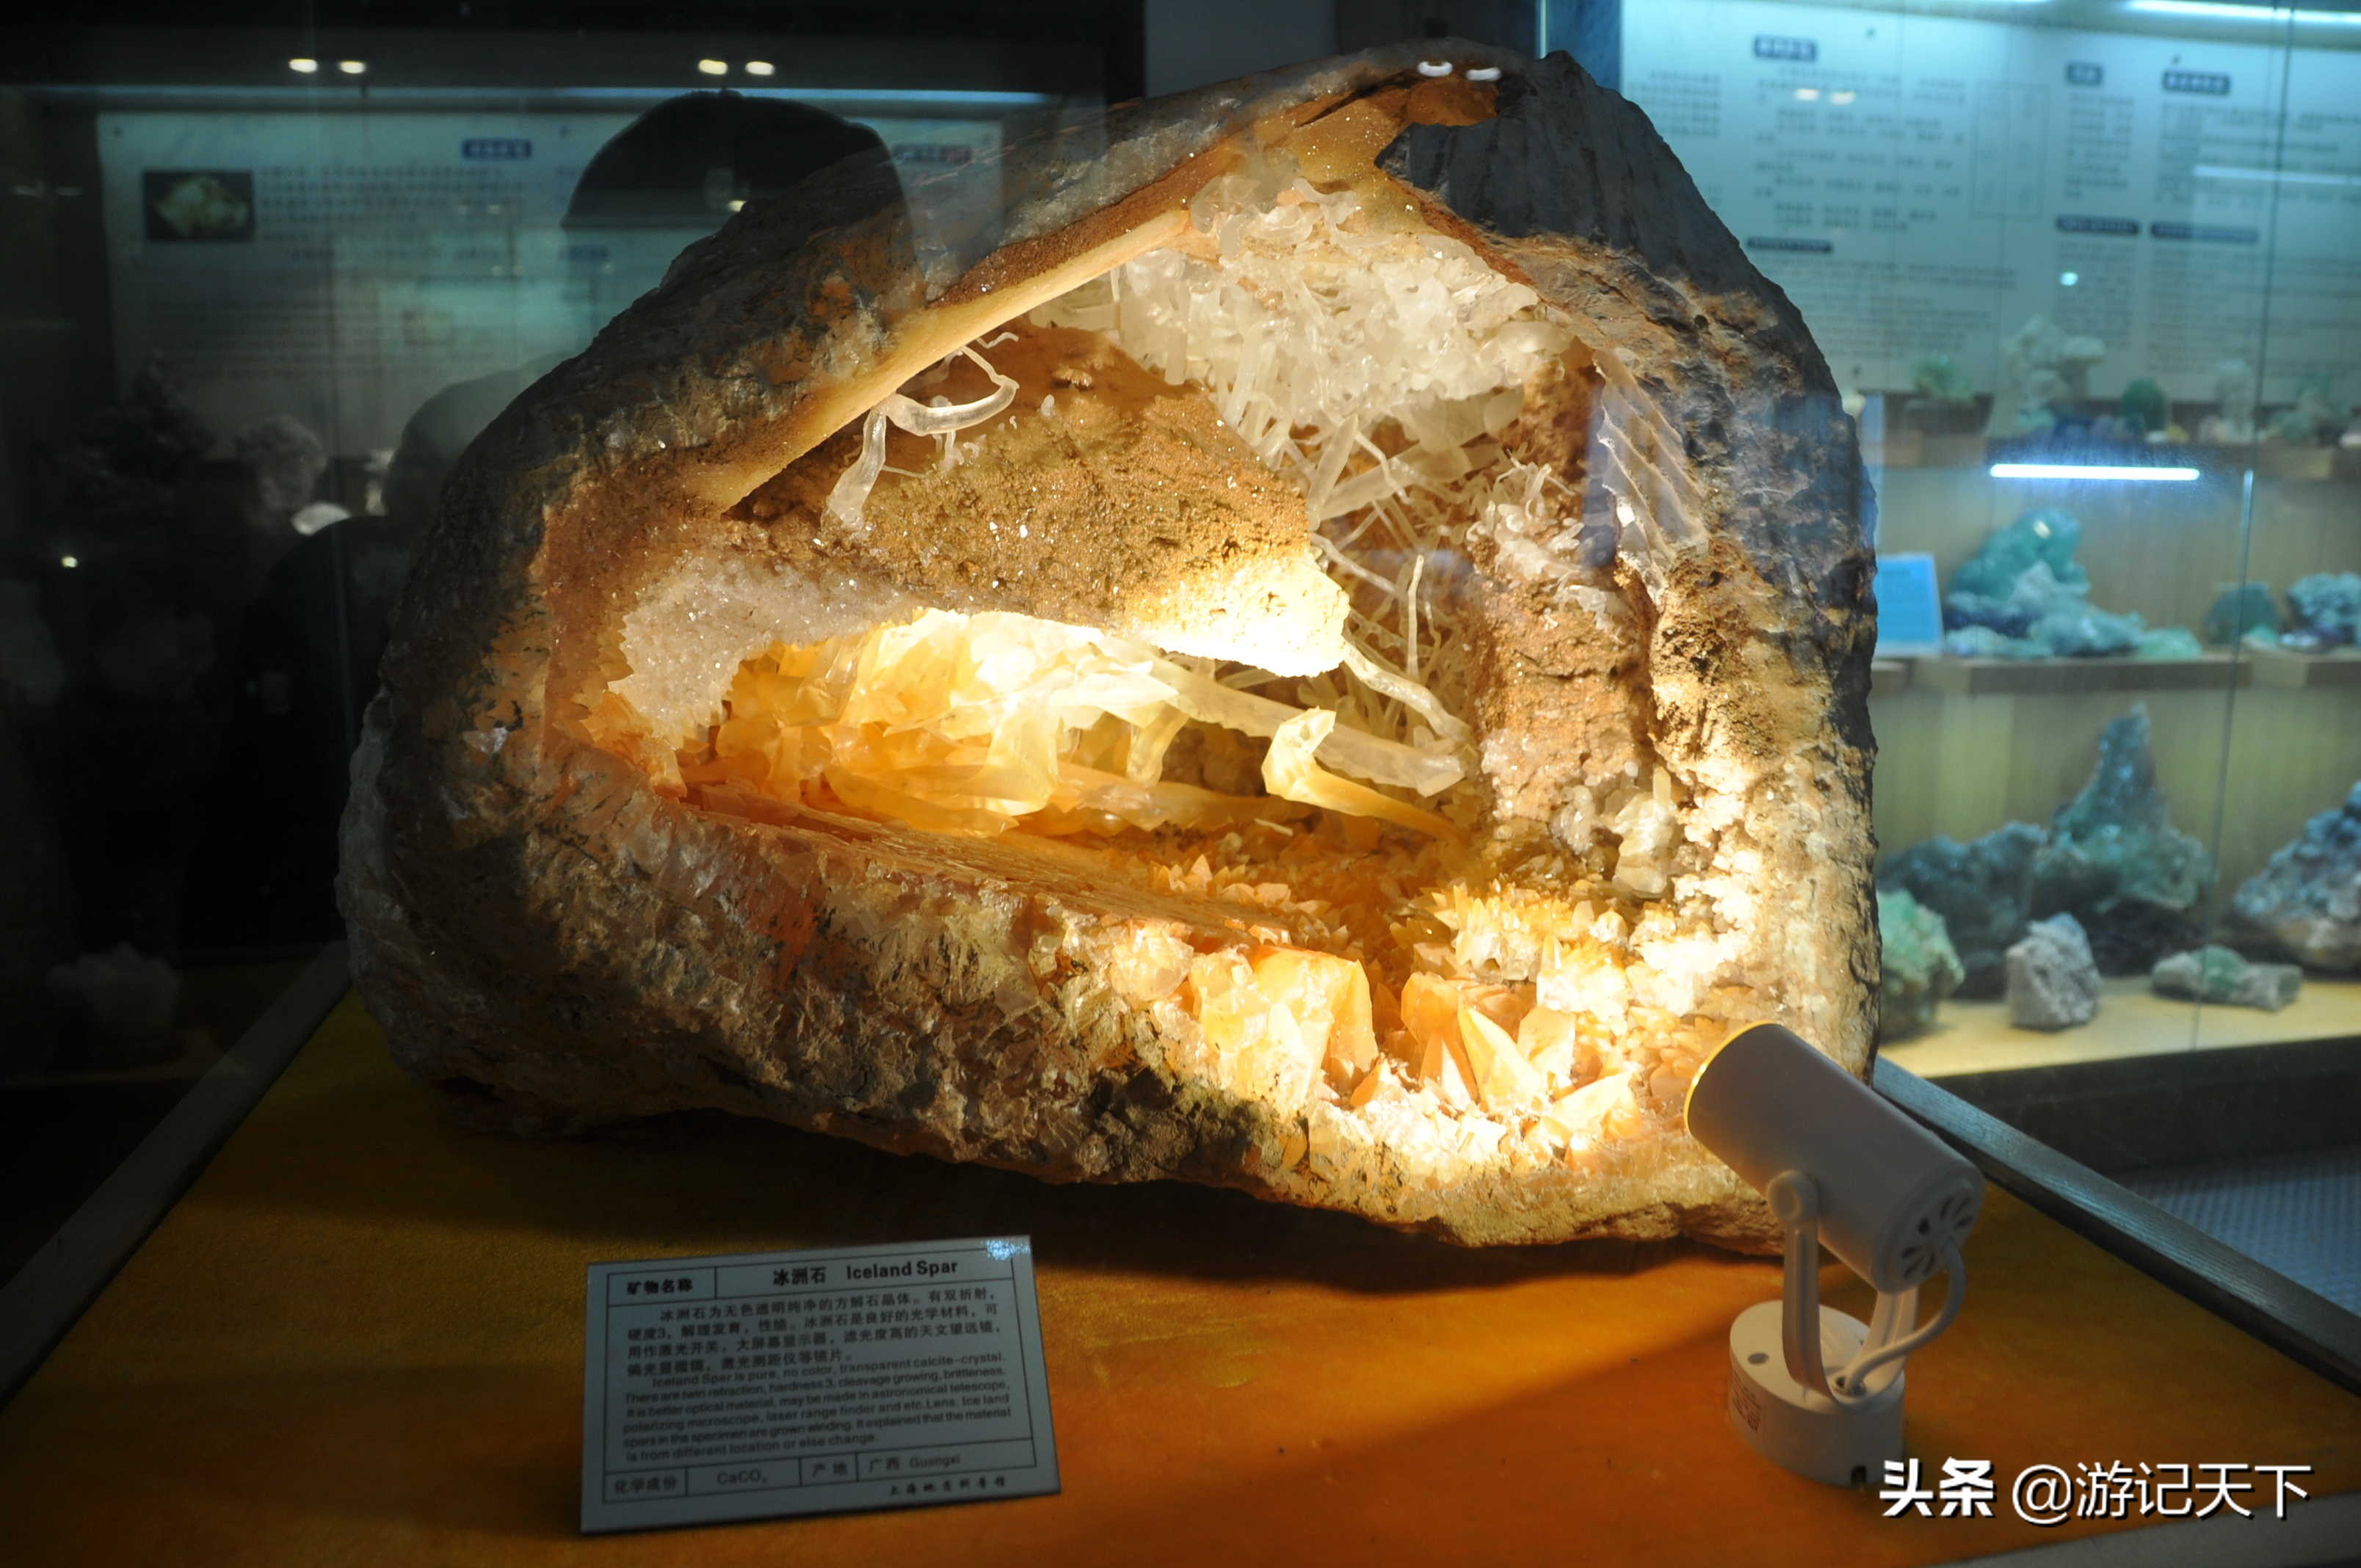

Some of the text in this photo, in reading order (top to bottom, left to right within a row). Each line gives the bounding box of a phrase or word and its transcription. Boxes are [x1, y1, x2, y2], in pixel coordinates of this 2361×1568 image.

[773, 1260, 958, 1285] 冰洲石 Iceland Spar
[627, 1278, 692, 1293] 矿物名称
[652, 1374, 698, 1387] Iceland
[702, 1372, 731, 1386] Spar
[839, 1359, 910, 1376] transparent
[838, 1373, 891, 1389] cleavage
[685, 1401, 724, 1415] optical
[779, 1396, 803, 1408] may
[822, 1390, 856, 1402] made
[871, 1384, 947, 1398] astronomical
[766, 1409, 797, 1421] laser
[800, 1408, 837, 1421] range
[839, 1403, 875, 1415] finder
[877, 1401, 901, 1412] and
[639, 1448, 670, 1461] from
[672, 1444, 727, 1458] different
[729, 1440, 780, 1453] location
[799, 1436, 824, 1448] else
